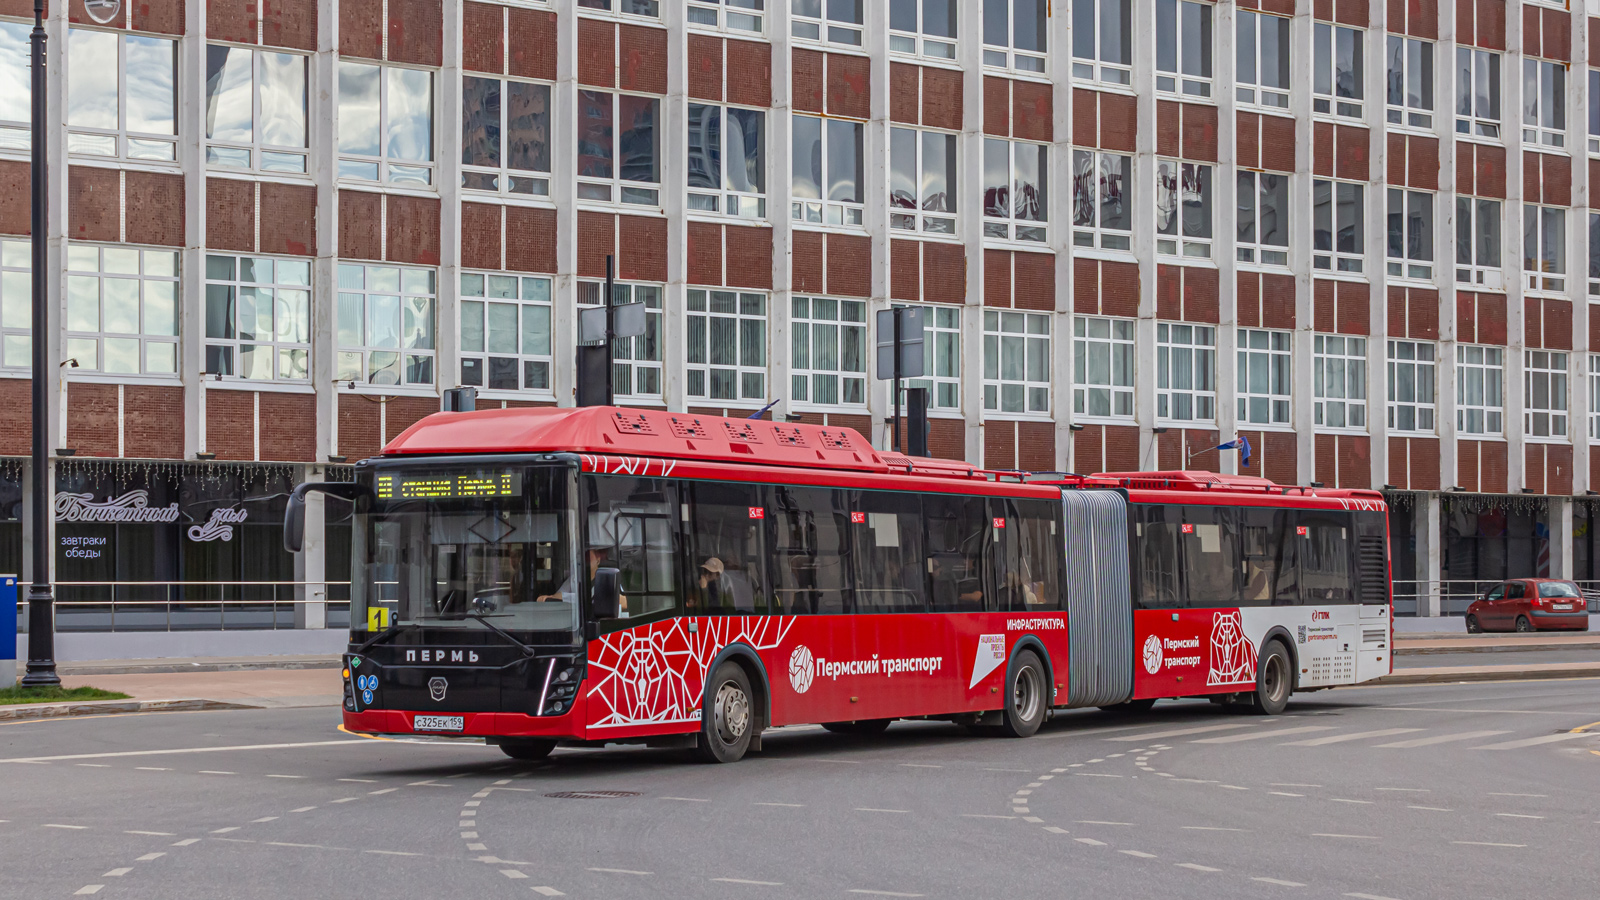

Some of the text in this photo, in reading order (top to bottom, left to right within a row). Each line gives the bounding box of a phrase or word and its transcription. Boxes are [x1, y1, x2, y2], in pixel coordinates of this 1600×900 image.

[55, 490, 248, 541] Банкетный зал
[61, 537, 106, 546] завтраки
[65, 547, 101, 558] обеды
[374, 610, 382, 631] 1
[1007, 618, 1065, 630] ИНФРАСТРУКТУРА
[1164, 636, 1200, 651] Пермский
[406, 650, 479, 662] ПЕРМЬ
[816, 654, 942, 680] Пермский транспорт
[1164, 656, 1201, 669] транспорт
[450, 716, 462, 725] 159
